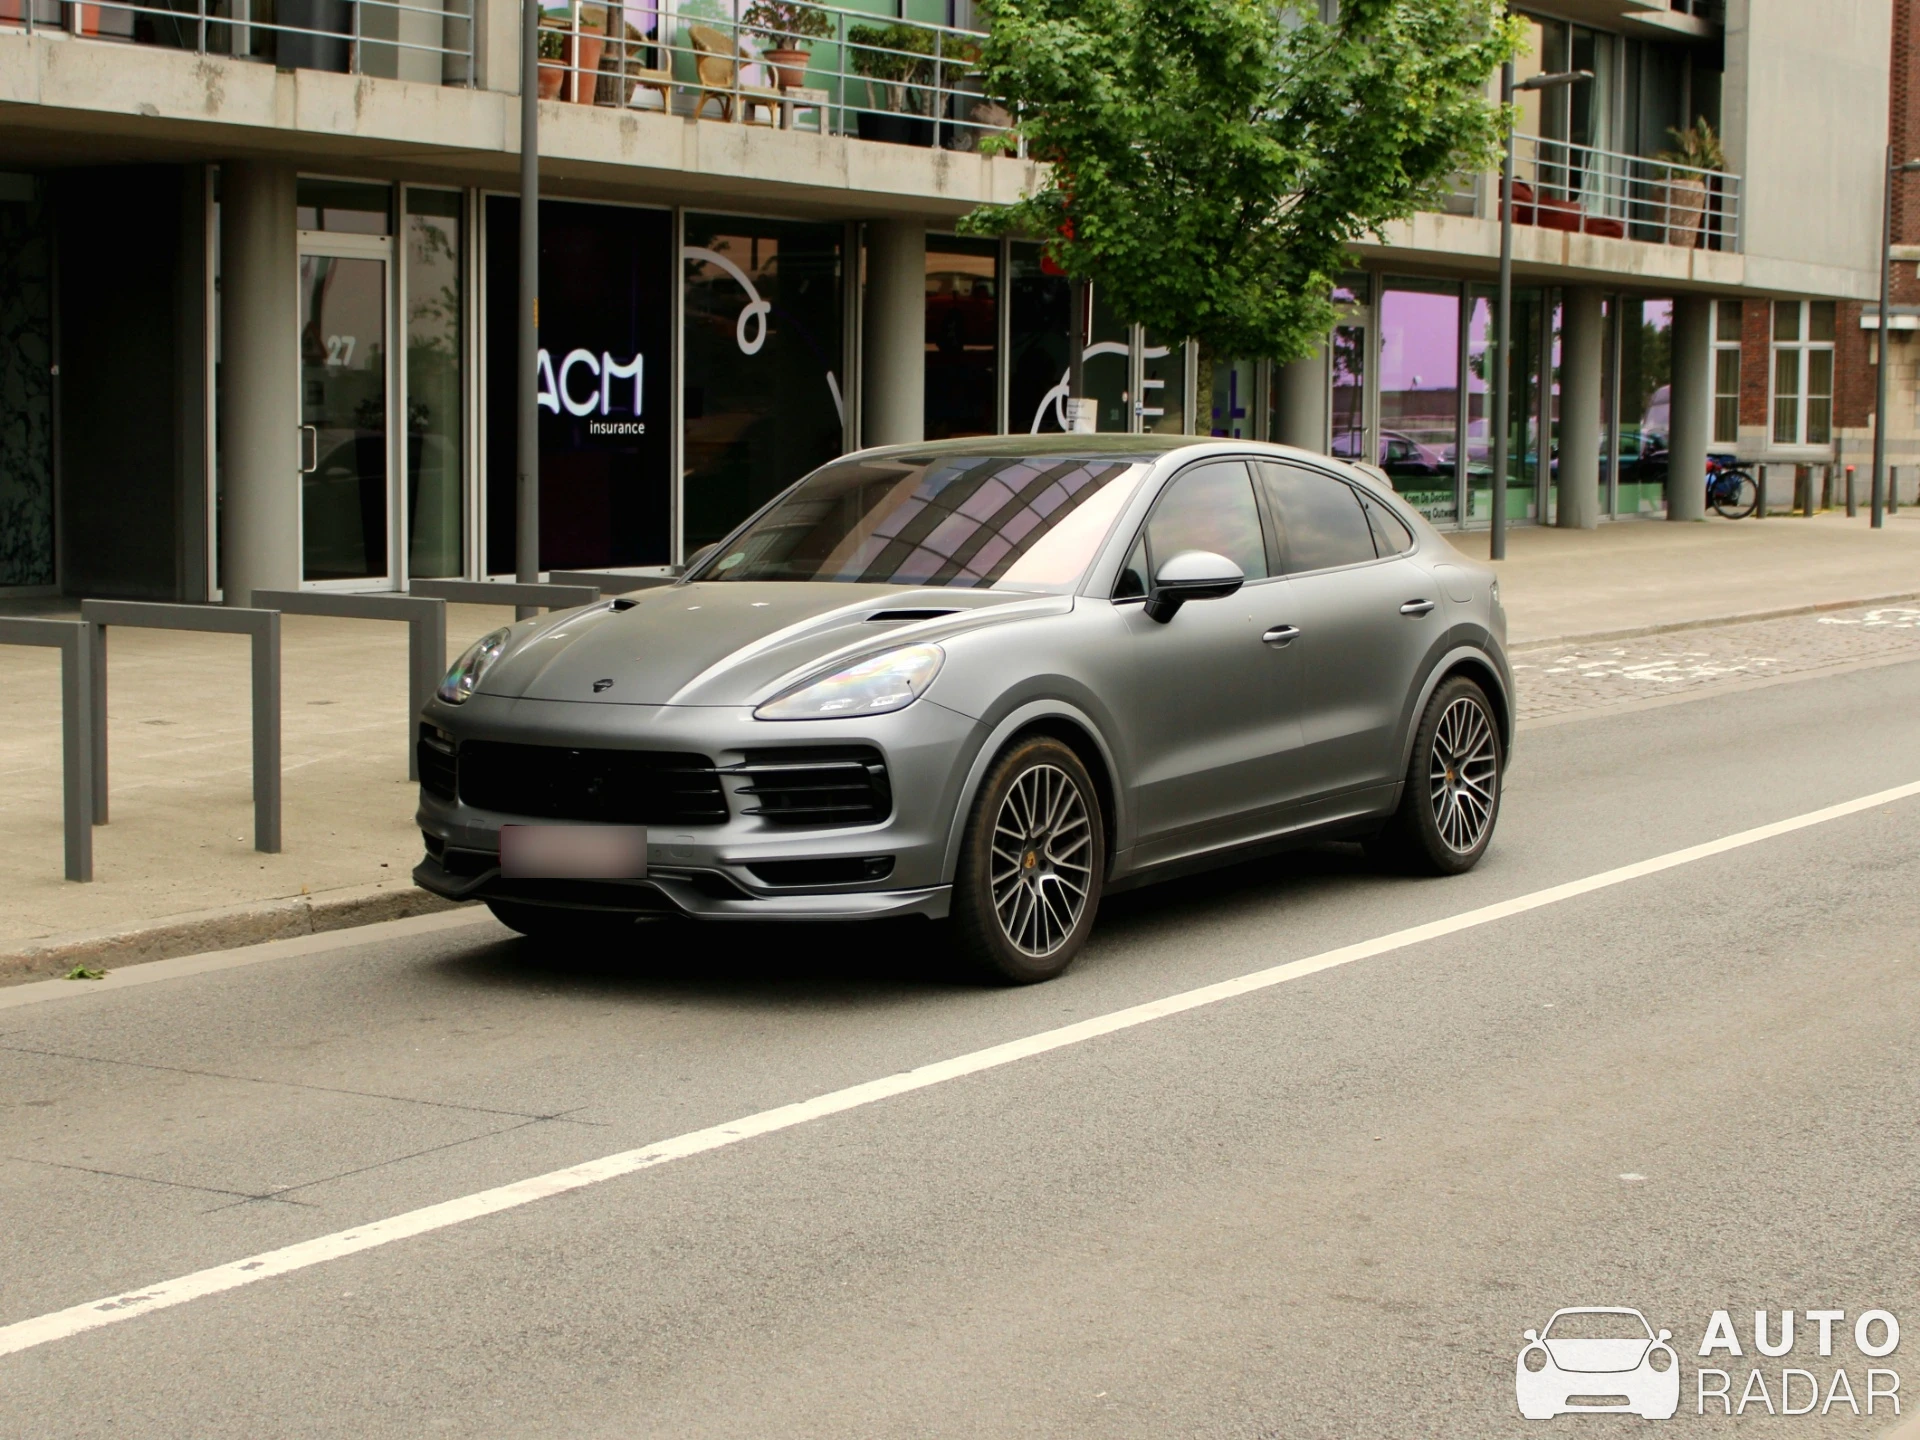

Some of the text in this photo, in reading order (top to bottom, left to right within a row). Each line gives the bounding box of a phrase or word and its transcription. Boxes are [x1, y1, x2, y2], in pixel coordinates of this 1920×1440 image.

[327, 335, 356, 366] 27
[537, 348, 643, 417] ACM
[590, 420, 645, 434] insurance
